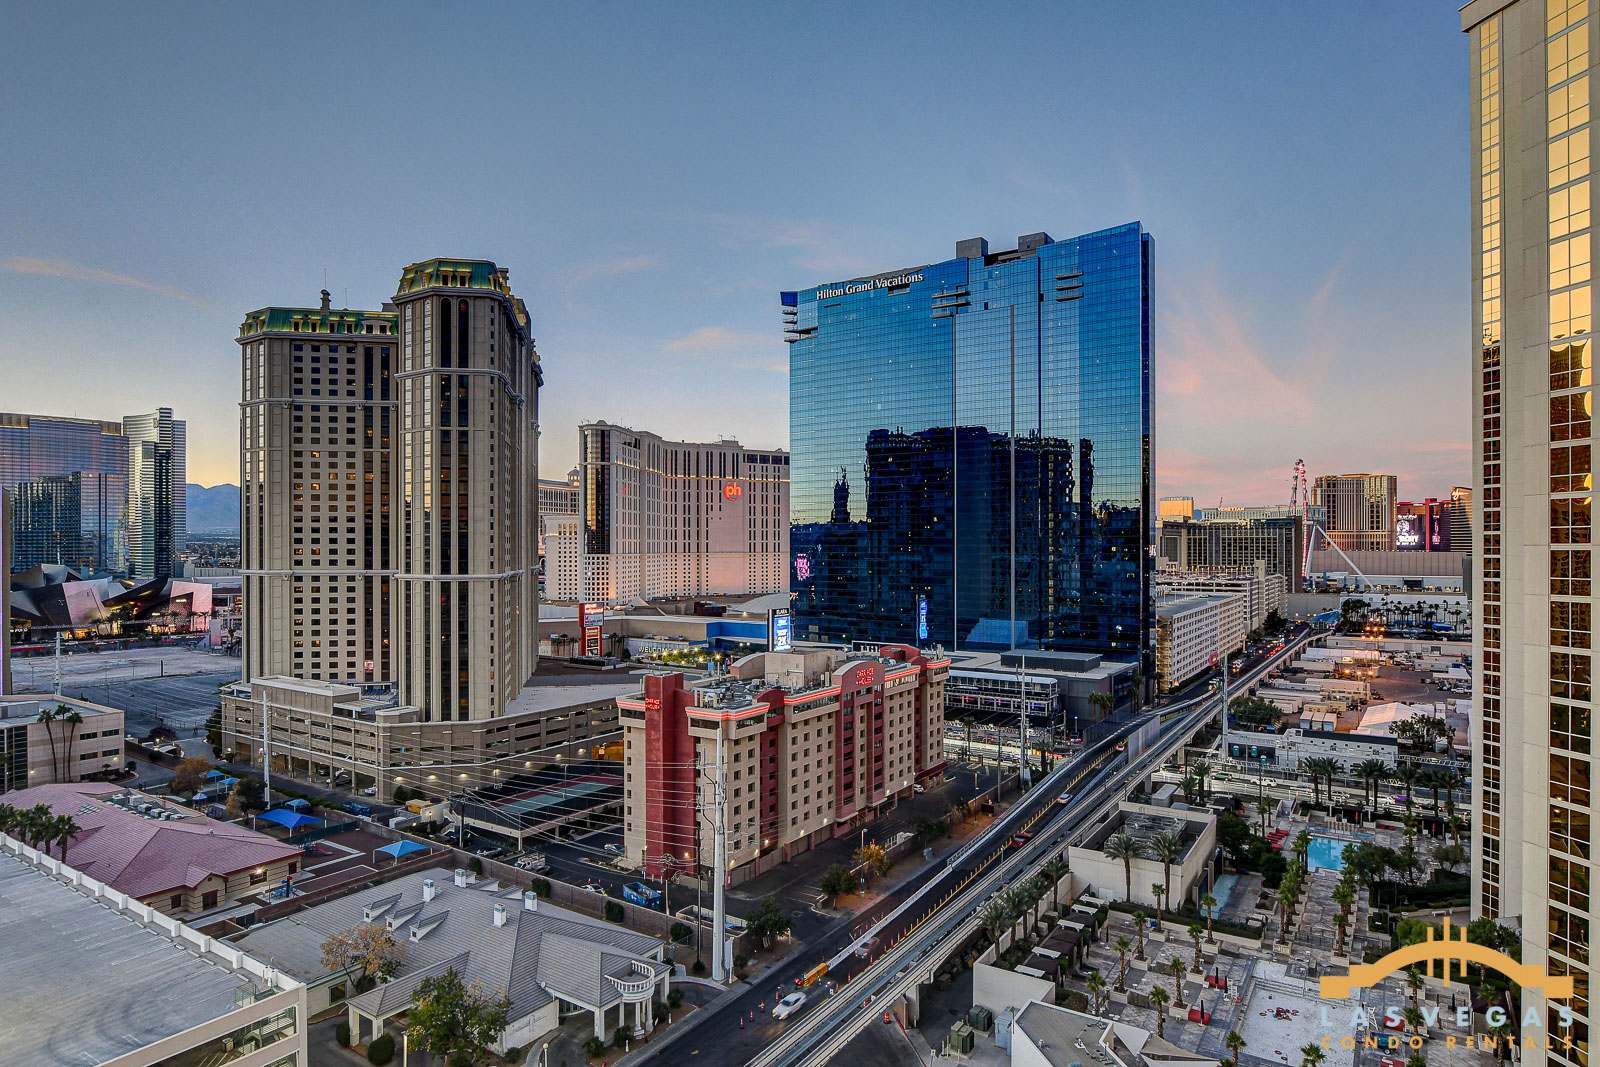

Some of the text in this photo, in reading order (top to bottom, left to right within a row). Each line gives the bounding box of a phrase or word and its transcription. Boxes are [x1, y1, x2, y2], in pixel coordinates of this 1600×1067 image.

[816, 273, 923, 300] Hilton Grand Vacations
